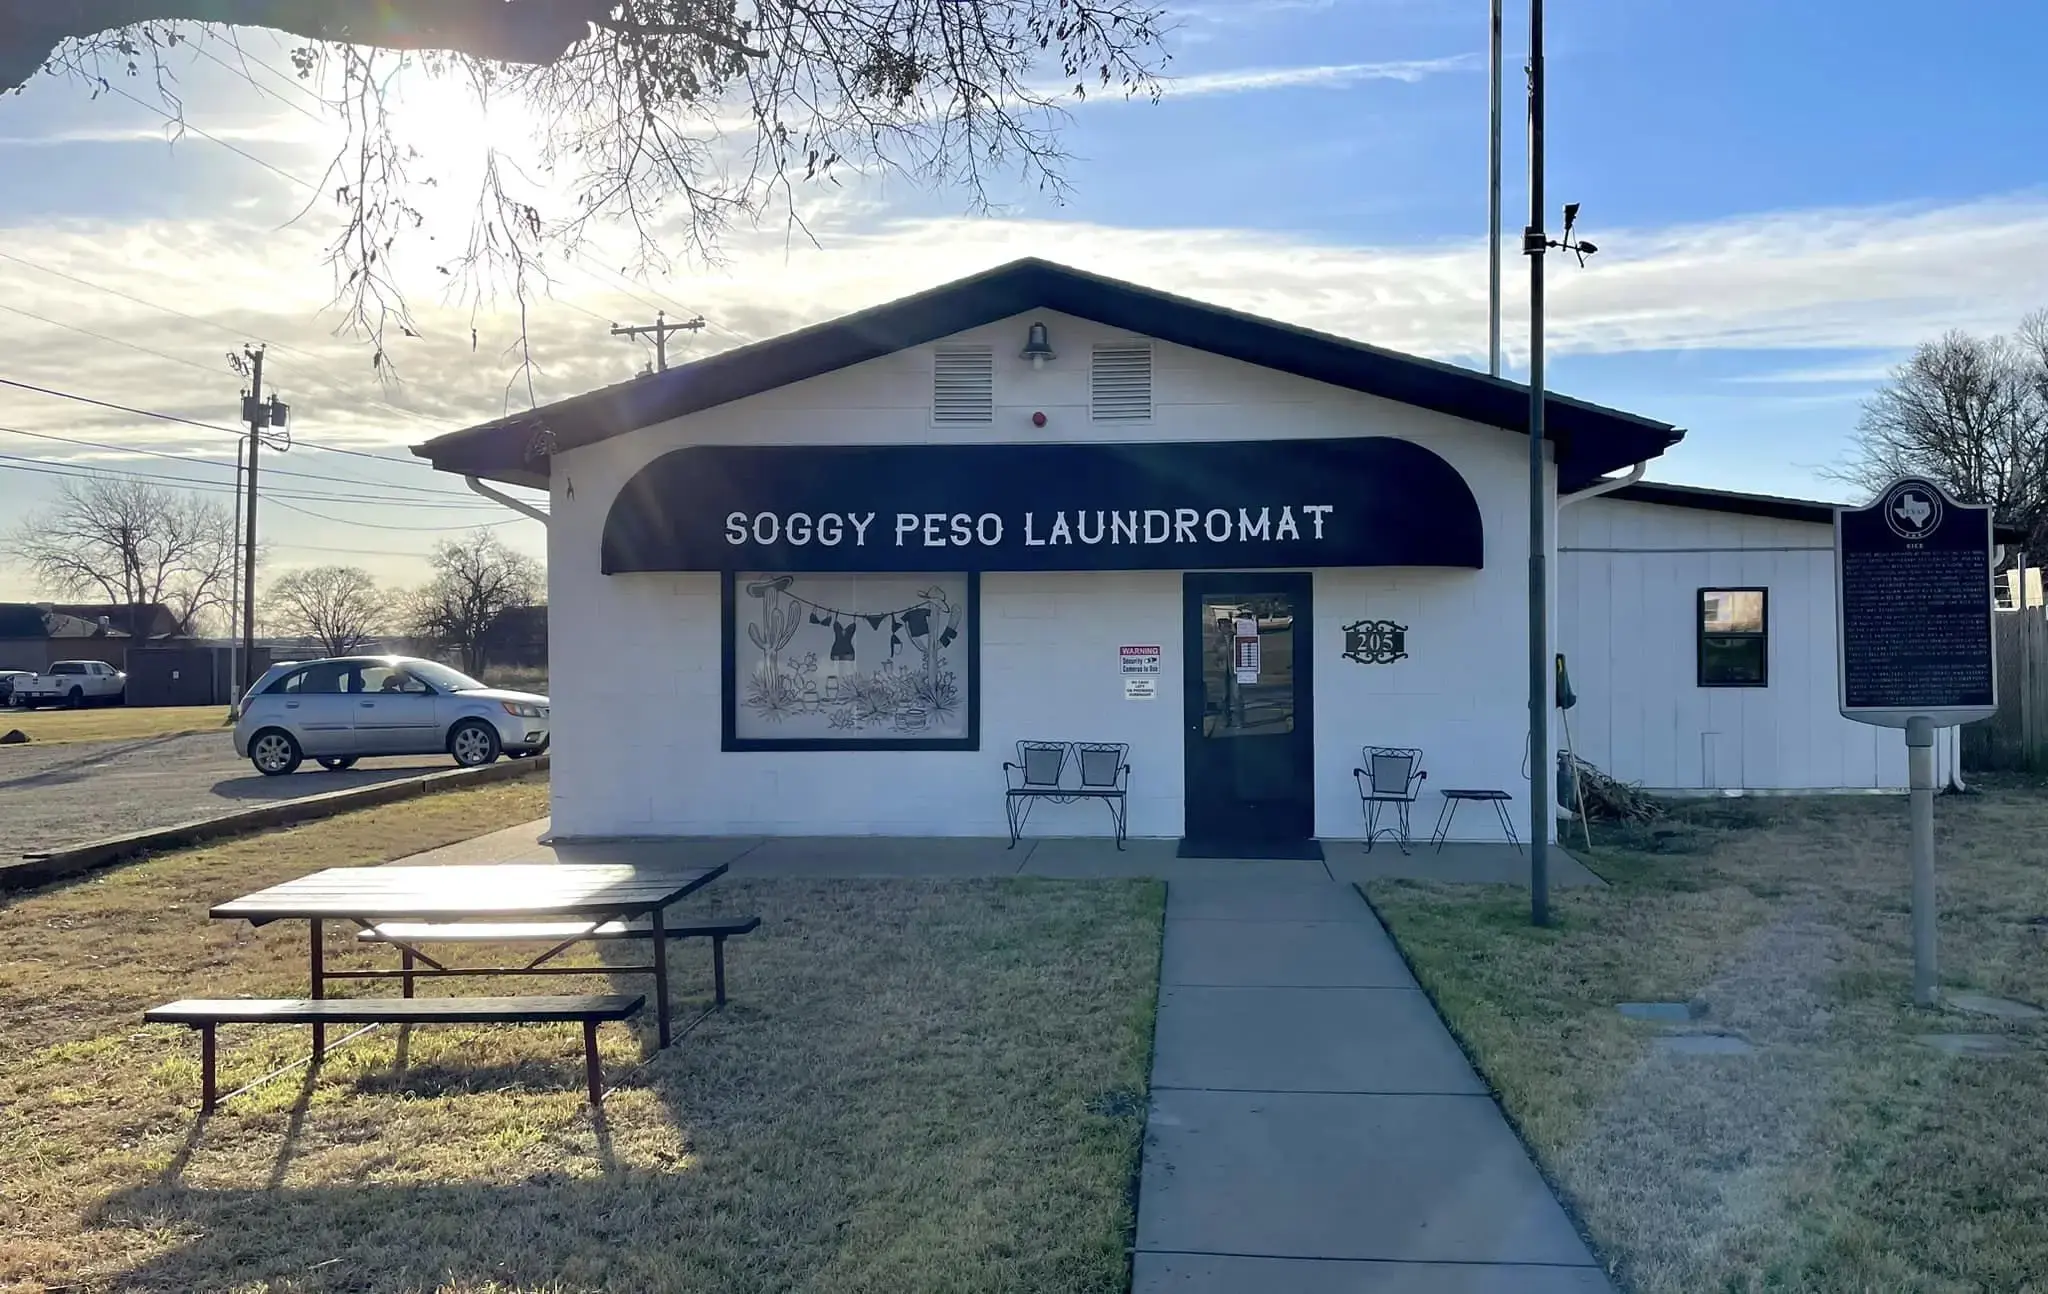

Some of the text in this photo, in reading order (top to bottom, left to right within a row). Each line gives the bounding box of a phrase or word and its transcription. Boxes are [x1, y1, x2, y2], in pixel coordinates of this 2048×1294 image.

[725, 505, 1334, 547] SOGGY PESO LAUNDROMAT
[1357, 634, 1393, 651] 205
[1122, 647, 1158, 655] WARNING
[1123, 657, 1142, 665] Security
